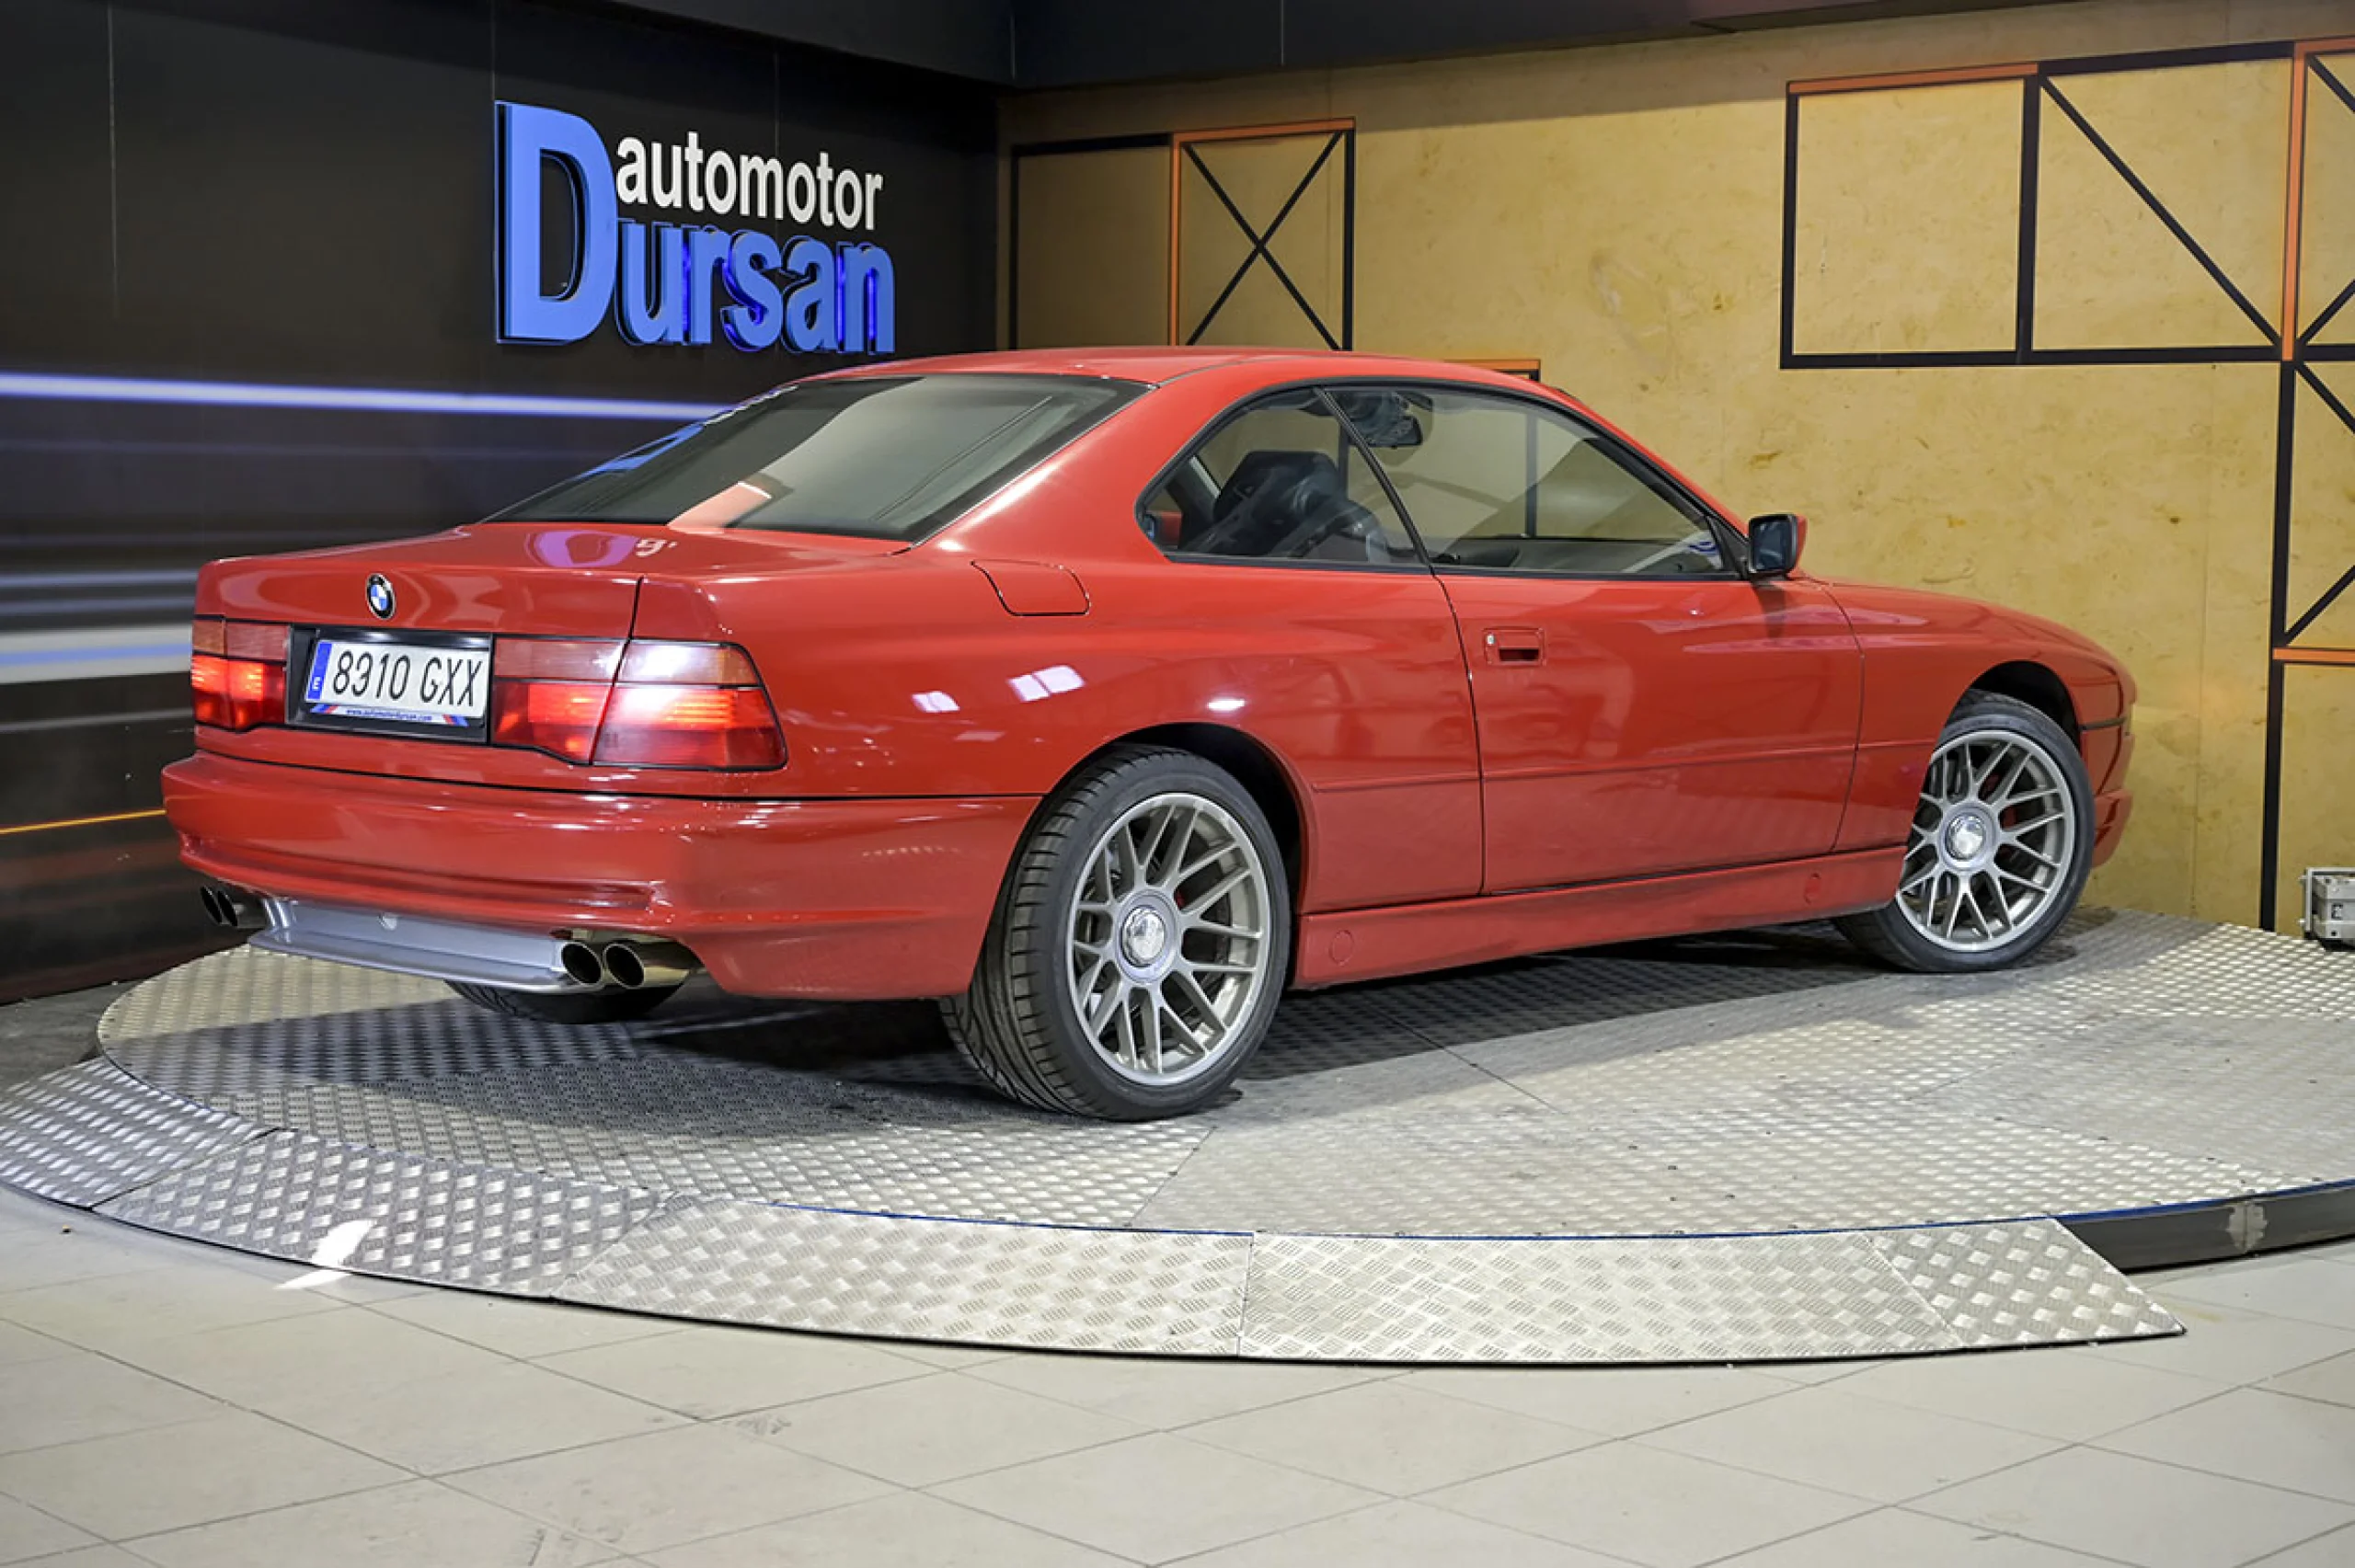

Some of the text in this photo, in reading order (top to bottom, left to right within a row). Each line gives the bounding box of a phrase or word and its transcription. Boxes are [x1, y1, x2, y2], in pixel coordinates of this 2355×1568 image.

[495, 100, 896, 354] Dursan
[616, 132, 883, 230] automotor
[312, 650, 483, 706] E 8310 GXX
